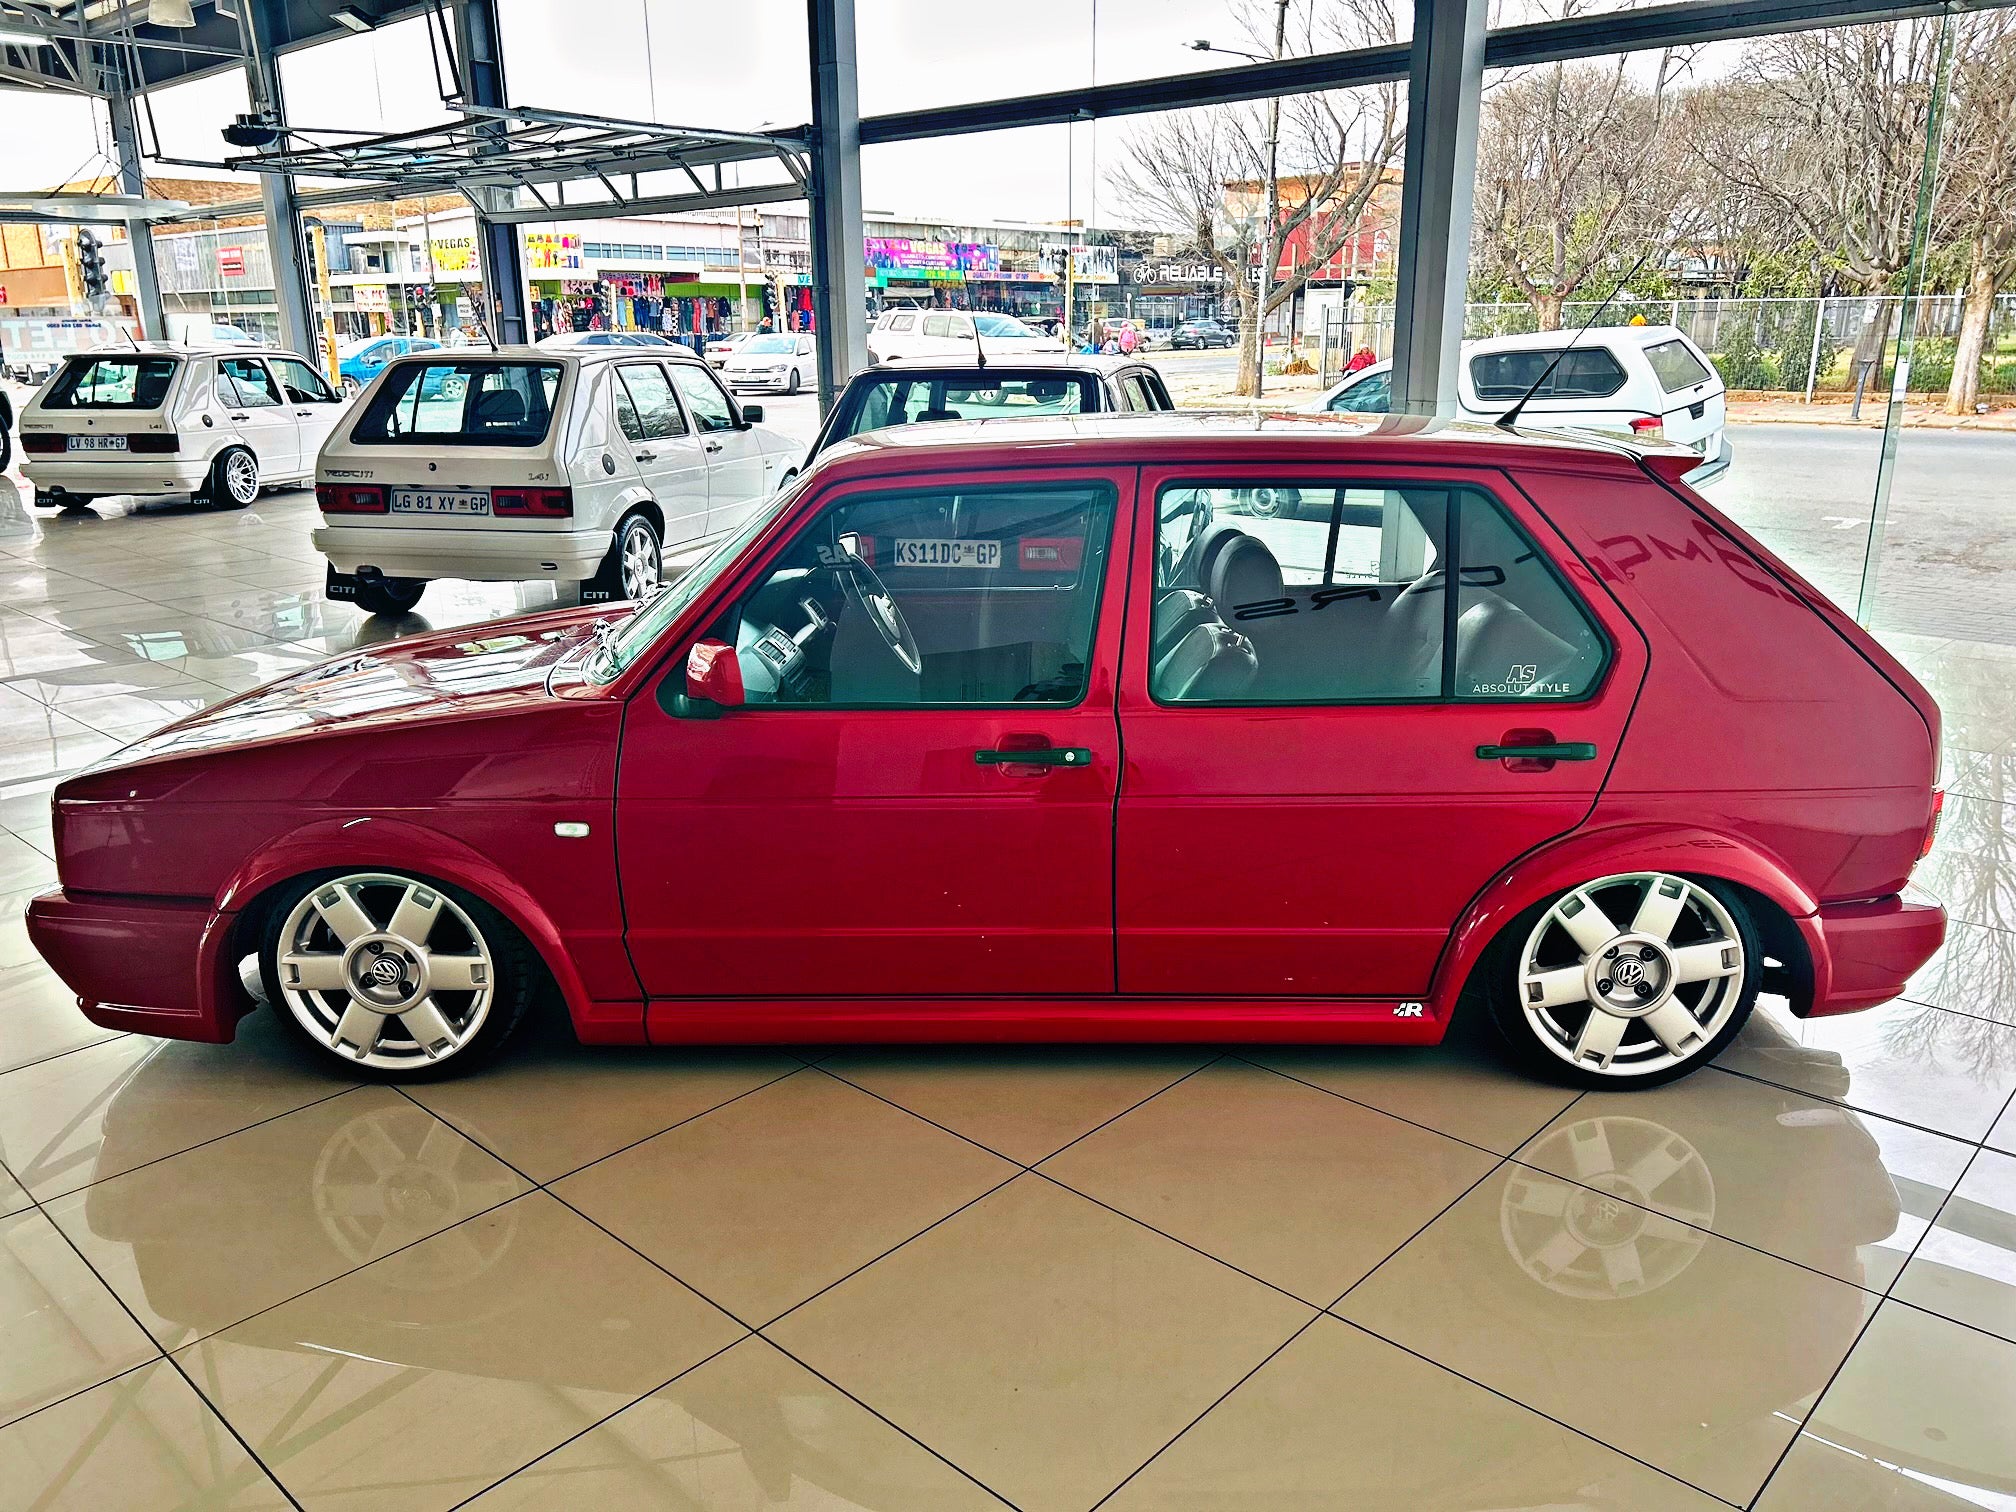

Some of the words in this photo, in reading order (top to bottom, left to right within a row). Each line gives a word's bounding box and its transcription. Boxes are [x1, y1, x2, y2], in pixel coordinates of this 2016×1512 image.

[437, 237, 470, 250] VEGAS
[1159, 265, 1223, 282] RELIABLE
[70, 437, 81, 448] LV
[84, 437, 95, 448] 98
[98, 437, 108, 448] HR
[115, 437, 125, 448] GP
[193, 498, 210, 506] CITI
[394, 494, 411, 509] LG
[416, 495, 433, 509] 81
[438, 496, 455, 511] XY
[470, 497, 487, 511] GP
[896, 542, 961, 564] KS11DC
[976, 543, 998, 565] GP
[329, 585, 356, 594] CITI
[583, 591, 610, 599] CITI
[1506, 664, 1537, 684] AS
